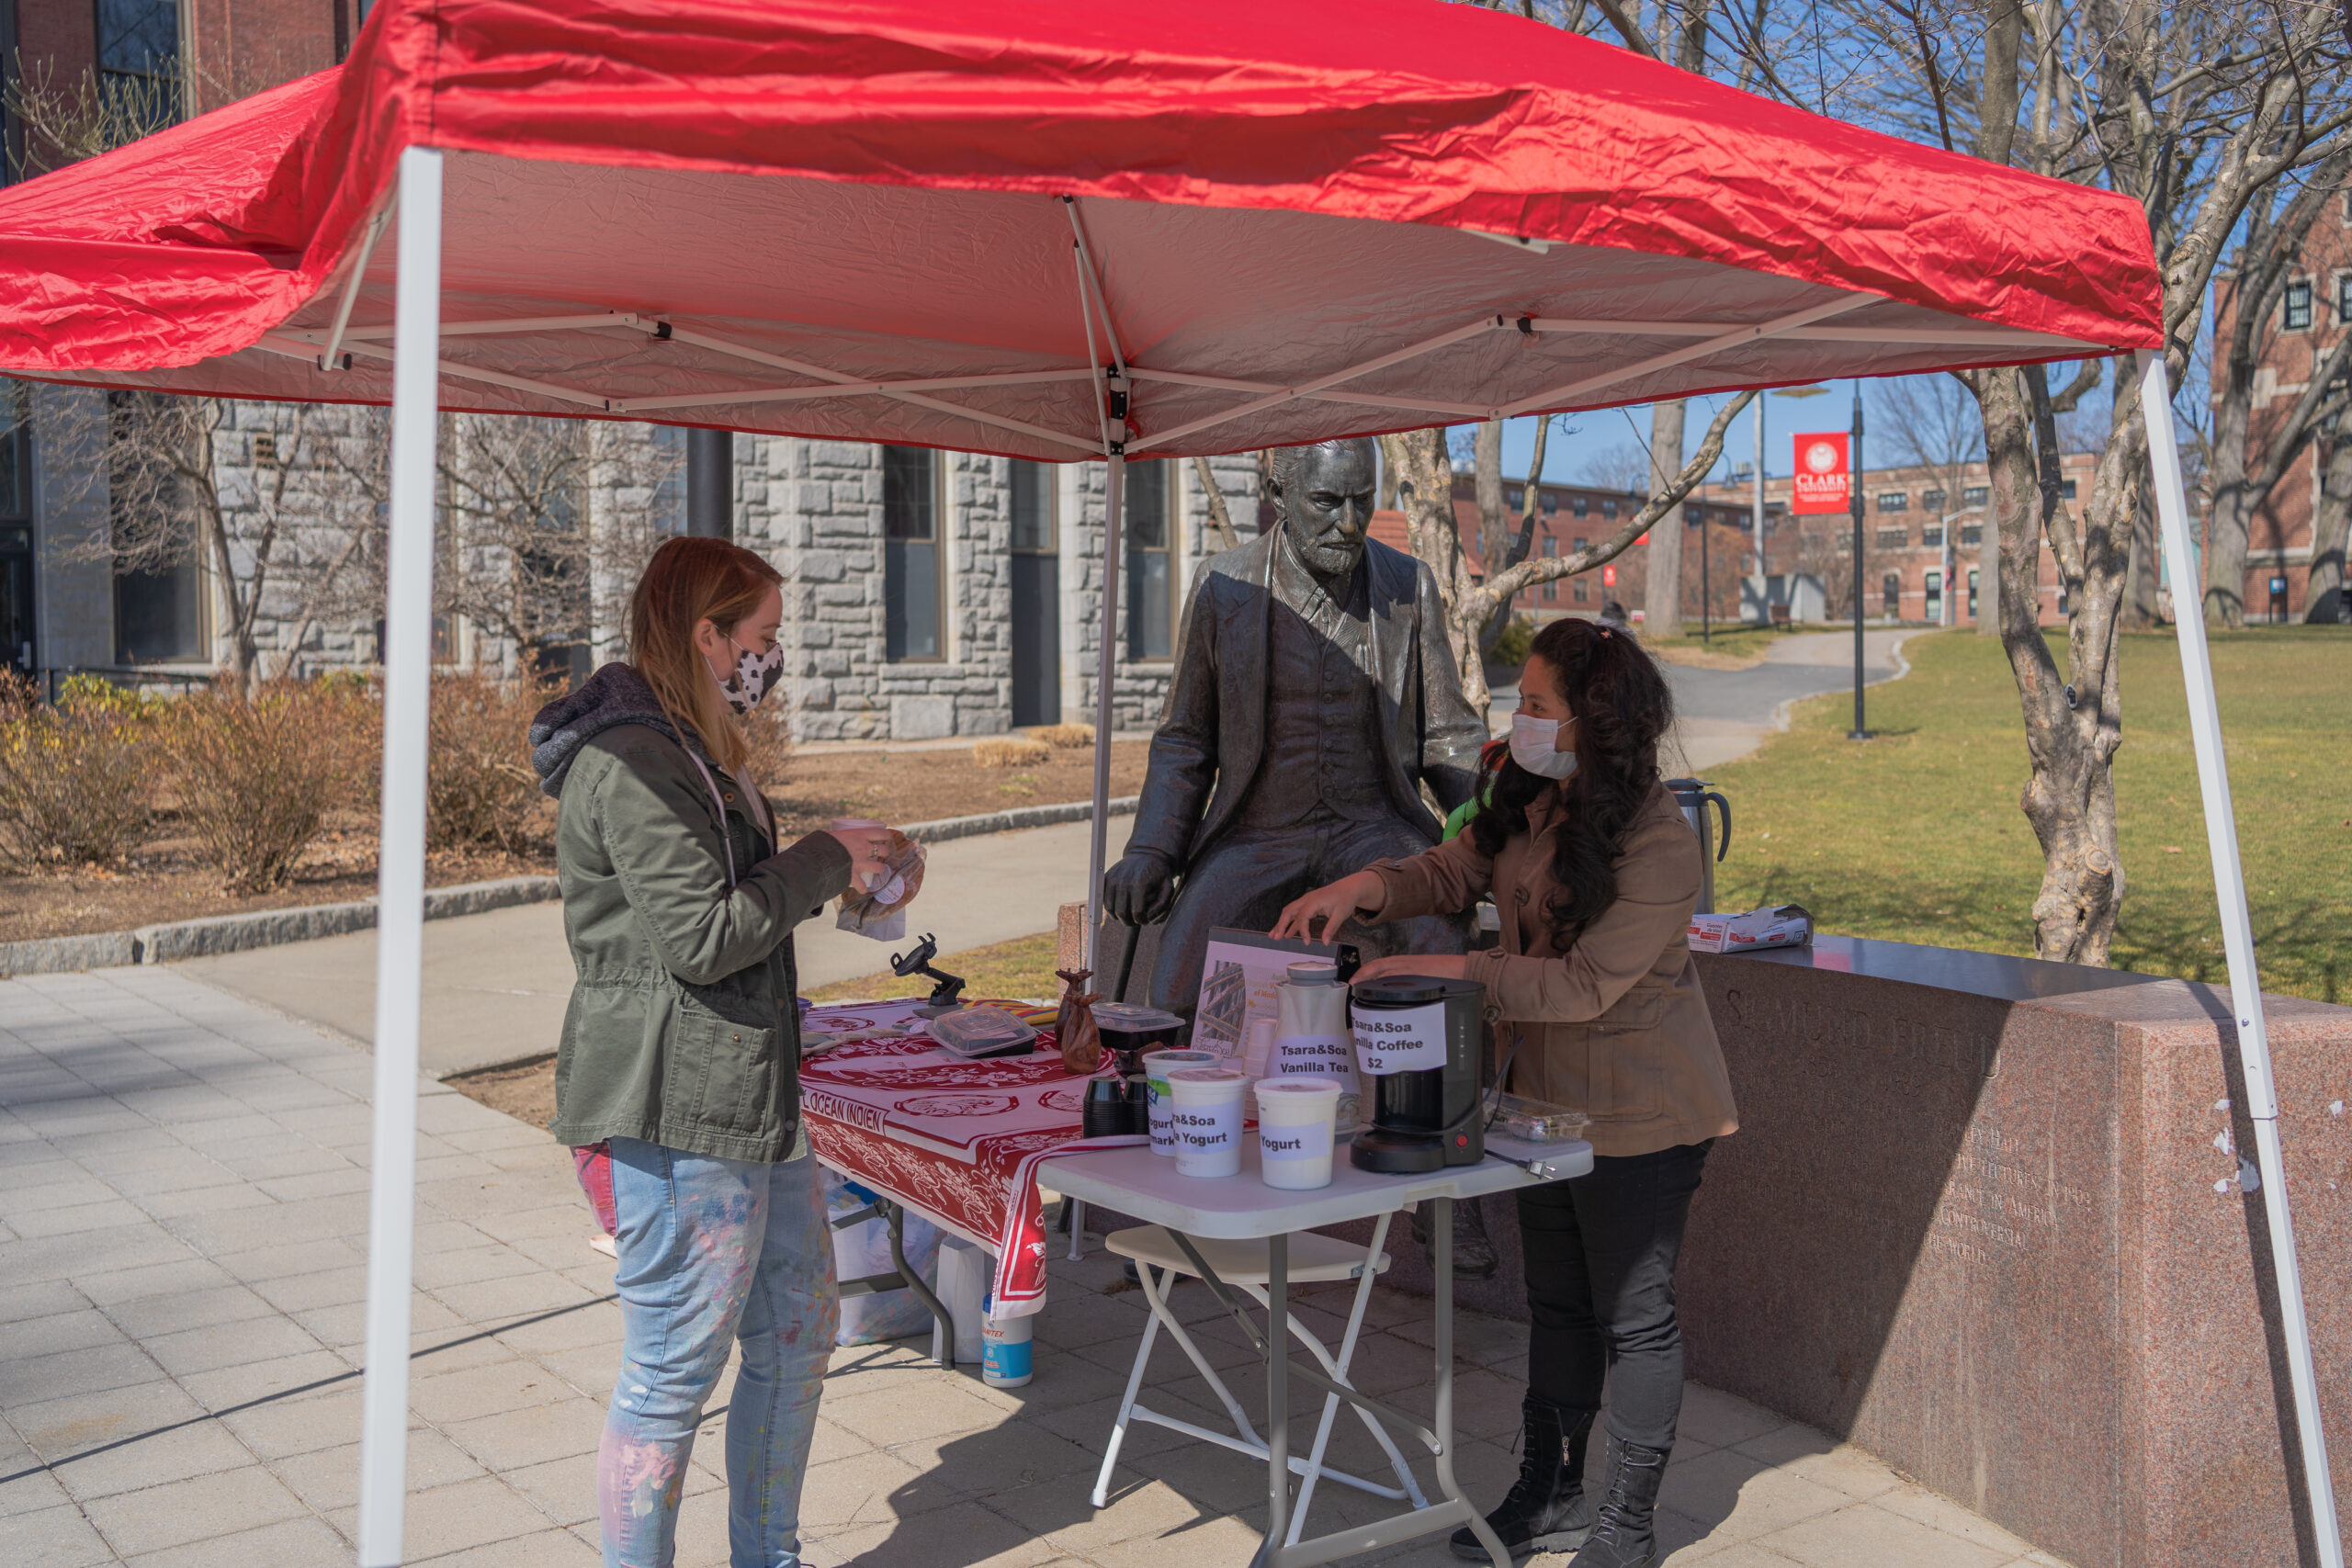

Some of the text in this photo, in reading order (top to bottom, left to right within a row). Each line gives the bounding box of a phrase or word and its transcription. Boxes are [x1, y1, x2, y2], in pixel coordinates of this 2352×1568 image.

[1795, 473, 1846, 486] CLARK
[1351, 1018, 1412, 1033] Tsara&Soa
[1281, 1044, 1347, 1056] Tsara&Soa
[1355, 1037, 1424, 1051] nilla Coffee
[1890, 1018, 2001, 1079] FREUD
[1281, 1062, 1349, 1074] Vanilla Tea
[1367, 1057, 1383, 1069] $2
[846, 1103, 881, 1133] INDIEN
[1149, 1118, 1174, 1130] ogurt
[1182, 1132, 1227, 1147] Yogurt
[1261, 1134, 1301, 1152] Yogurt
[1940, 1206, 2030, 1251] CONTROVERSIAL
